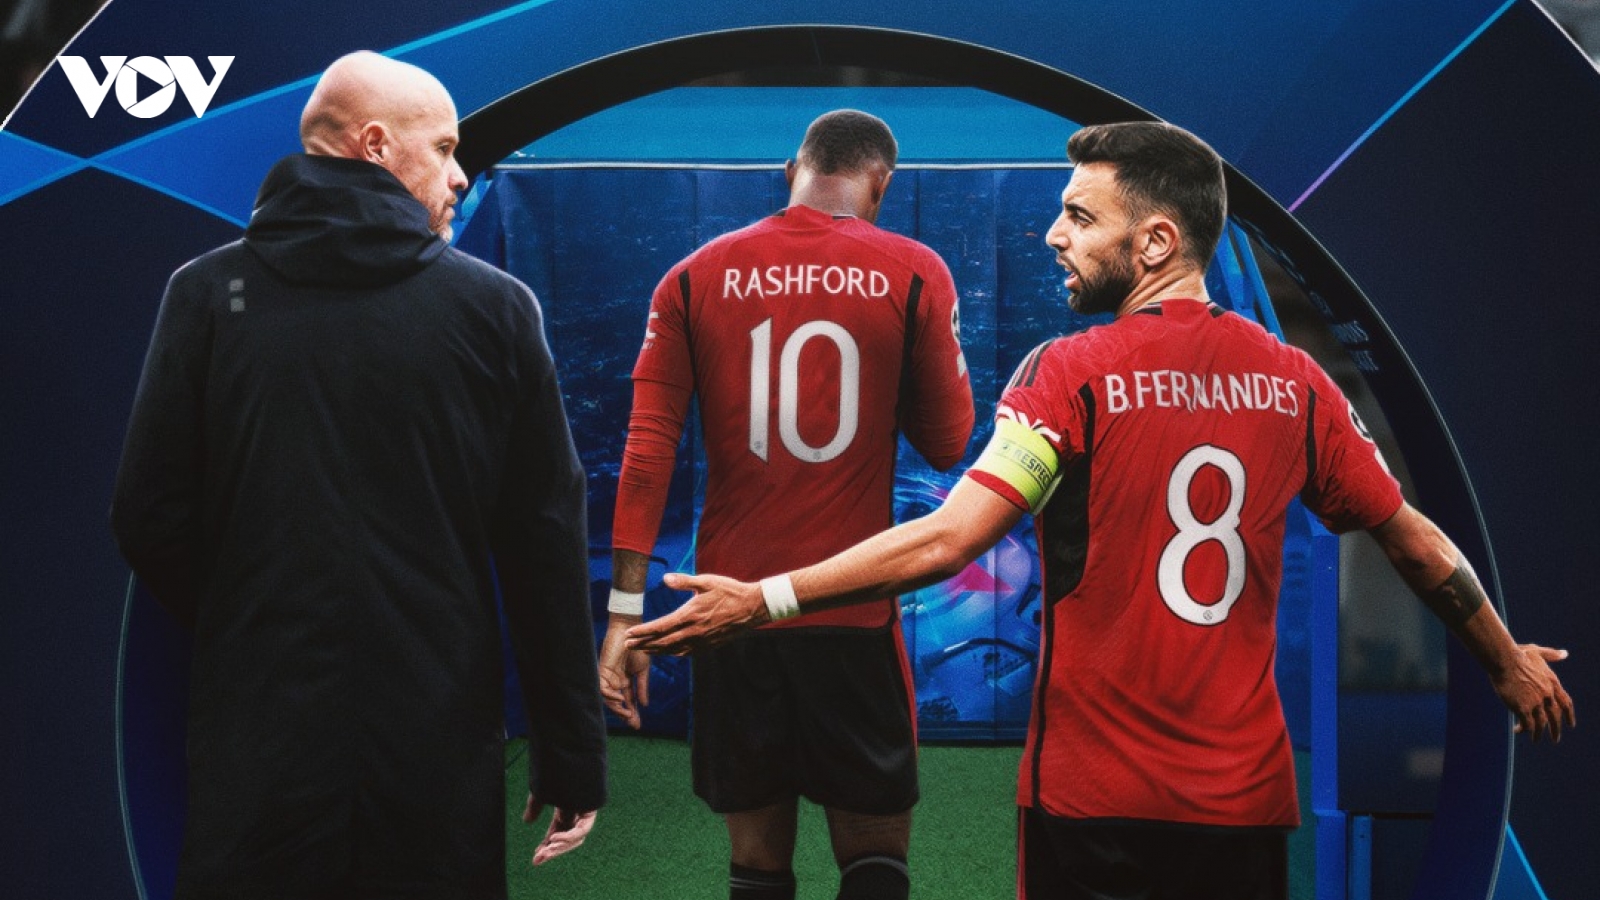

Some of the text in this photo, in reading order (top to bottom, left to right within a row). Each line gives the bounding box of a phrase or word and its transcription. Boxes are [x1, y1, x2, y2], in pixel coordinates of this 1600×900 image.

[722, 264, 890, 300] RASHFORD
[749, 316, 860, 463] 10
[1104, 369, 1299, 418] B.FERNANDES
[1014, 449, 1050, 488] RESPEC
[1157, 443, 1247, 626] 8
